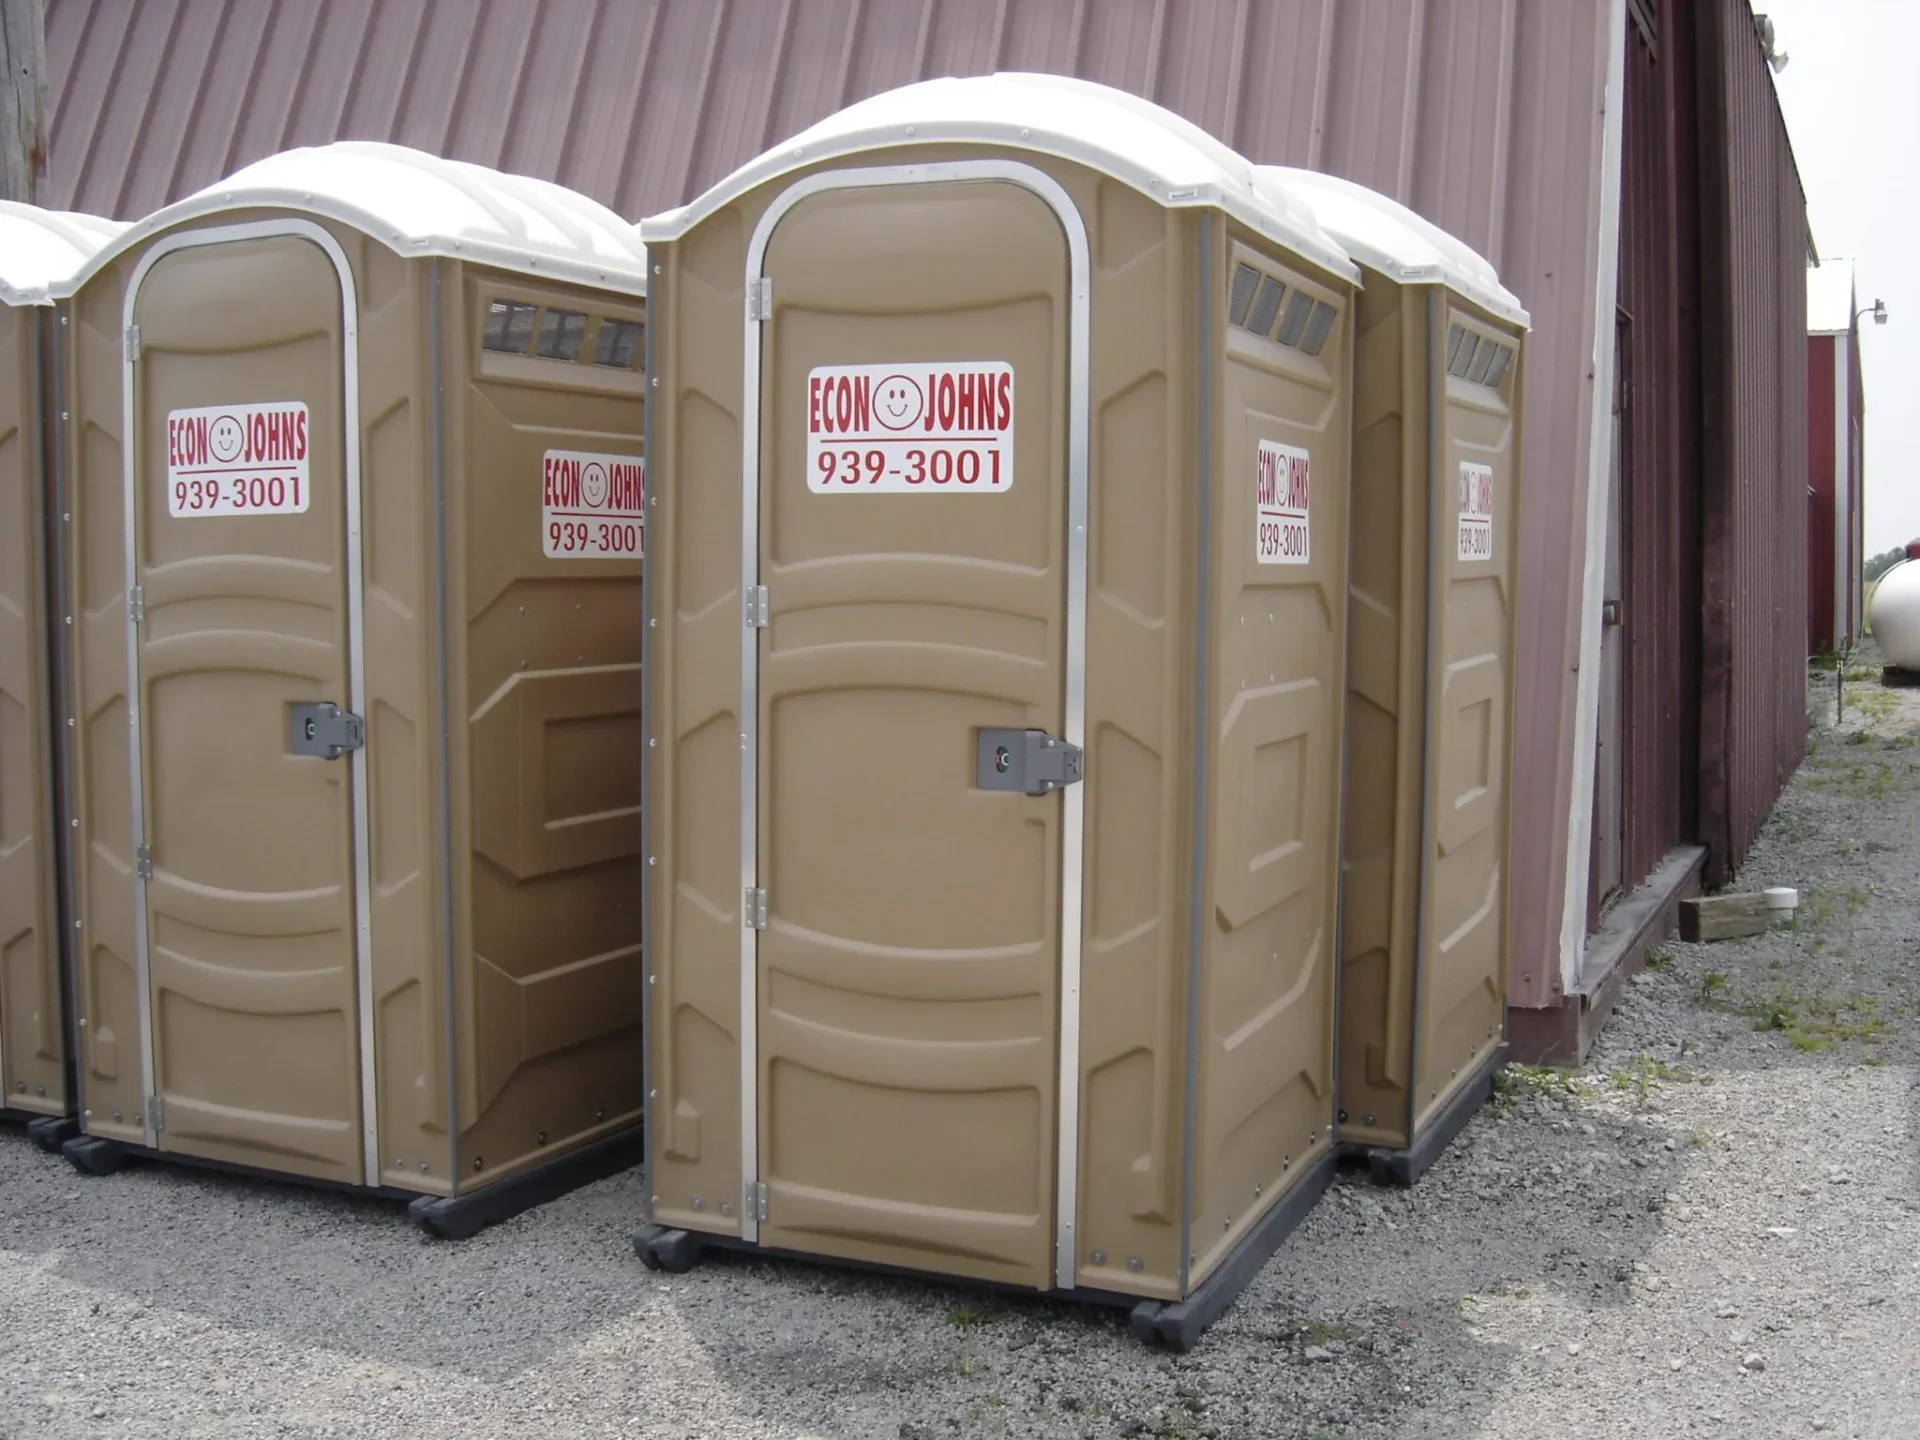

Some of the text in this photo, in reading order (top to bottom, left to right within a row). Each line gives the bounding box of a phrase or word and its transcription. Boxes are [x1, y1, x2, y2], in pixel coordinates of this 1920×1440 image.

[810, 372, 1010, 433] ECON JOHNS
[170, 410, 306, 466] ECON JOHNS
[545, 459, 580, 507] ECON
[818, 449, 999, 484] 939-3001
[1259, 449, 1276, 505] ECON
[176, 477, 299, 510] 939-3001
[550, 522, 644, 552] 939-3001
[1260, 522, 1307, 556] 939-3001
